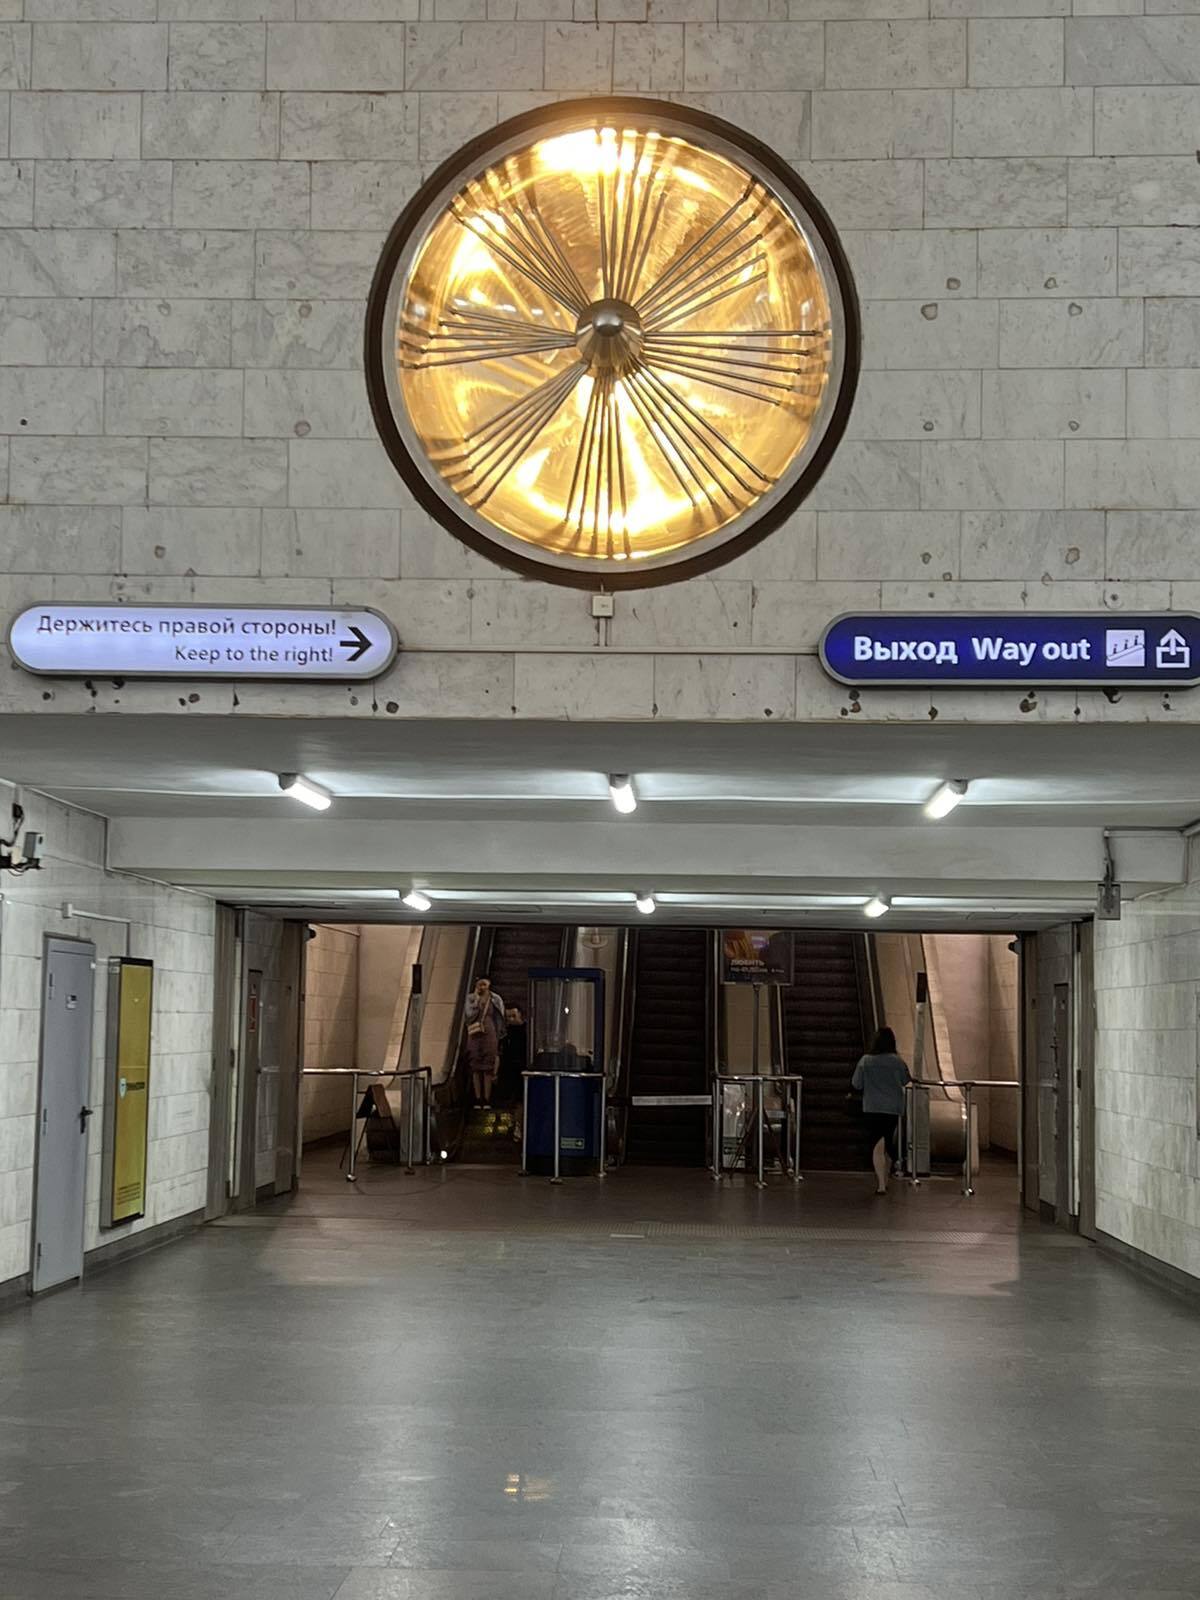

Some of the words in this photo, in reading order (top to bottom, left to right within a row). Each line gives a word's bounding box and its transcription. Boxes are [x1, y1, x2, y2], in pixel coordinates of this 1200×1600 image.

[37, 616, 153, 635] Держитесь
[159, 617, 235, 637] правой
[241, 618, 336, 637] стороны!
[175, 645, 221, 664] Keep
[226, 648, 245, 662] to
[249, 645, 280, 663] the
[285, 646, 333, 666] right!
[854, 635, 959, 666] Выход
[972, 637, 1037, 667] Way
[1042, 638, 1091, 661] out
